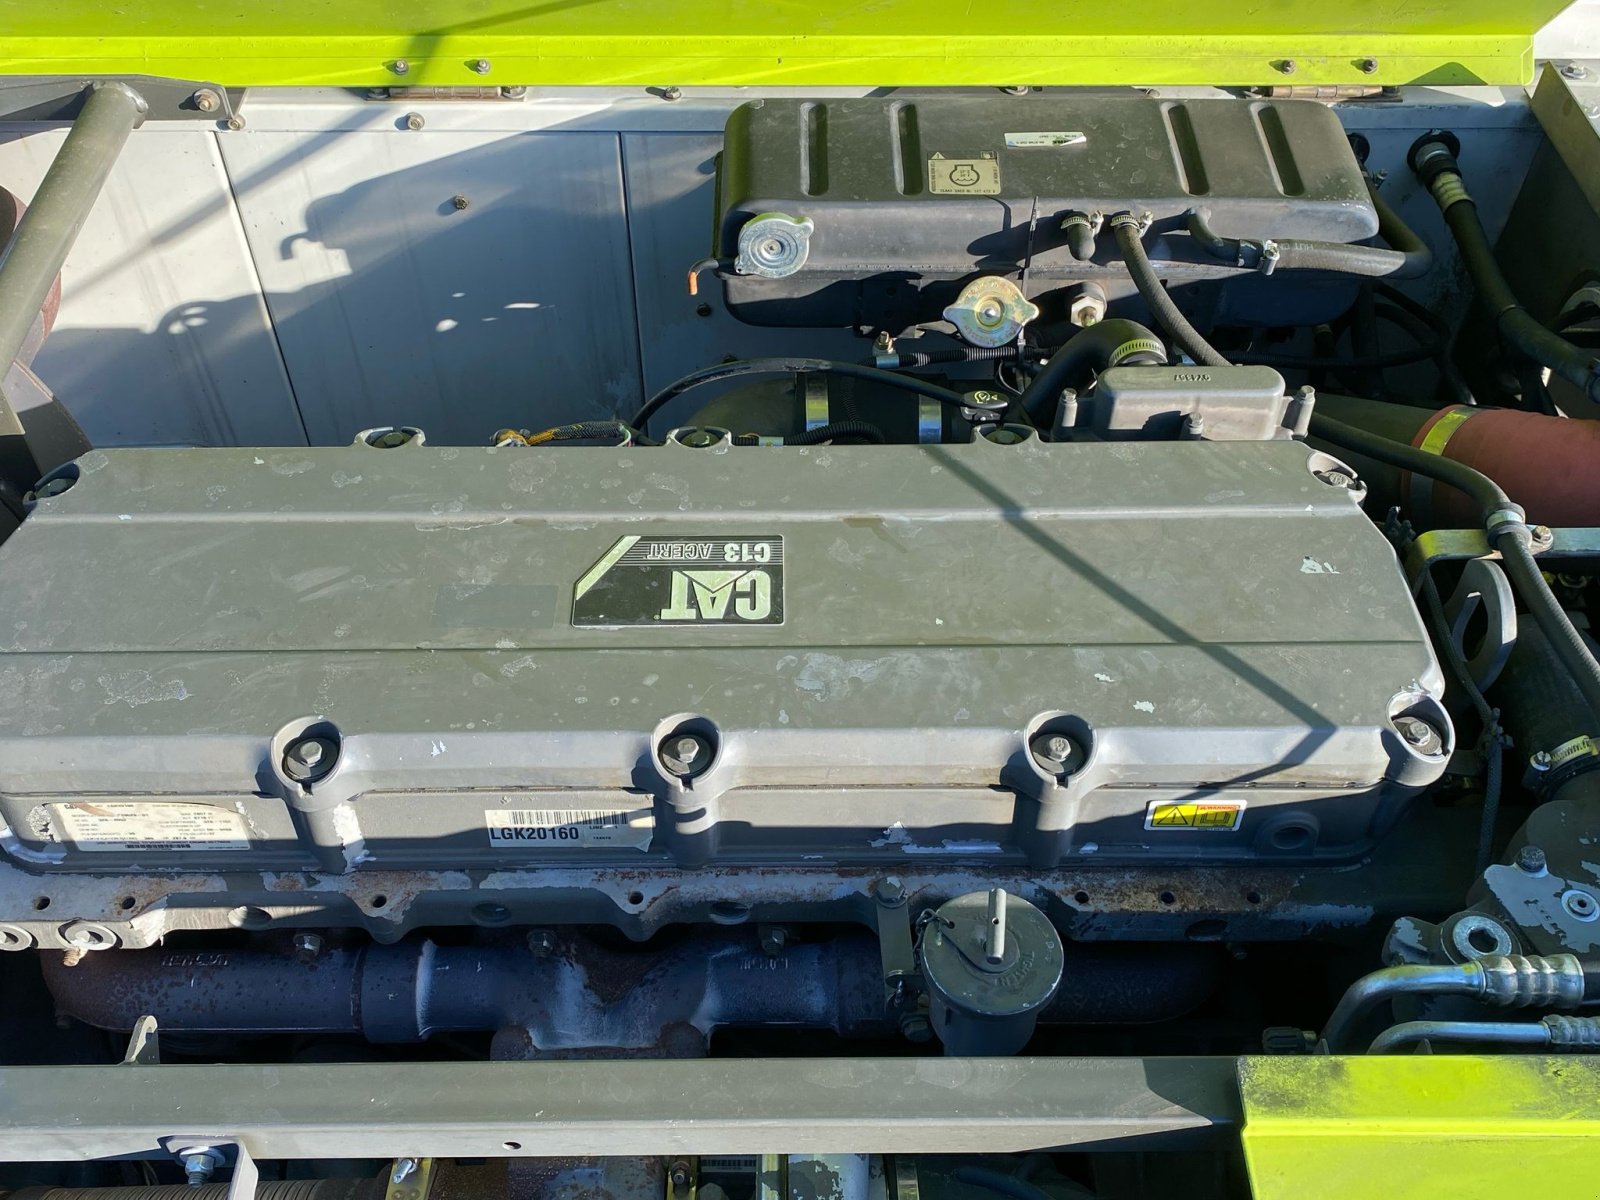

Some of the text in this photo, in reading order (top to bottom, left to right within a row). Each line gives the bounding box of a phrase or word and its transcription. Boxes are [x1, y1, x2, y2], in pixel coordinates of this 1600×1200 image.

[647, 542, 771, 563] C13 ACERT
[660, 570, 771, 620] CAT
[490, 826, 579, 841] LGK20160
